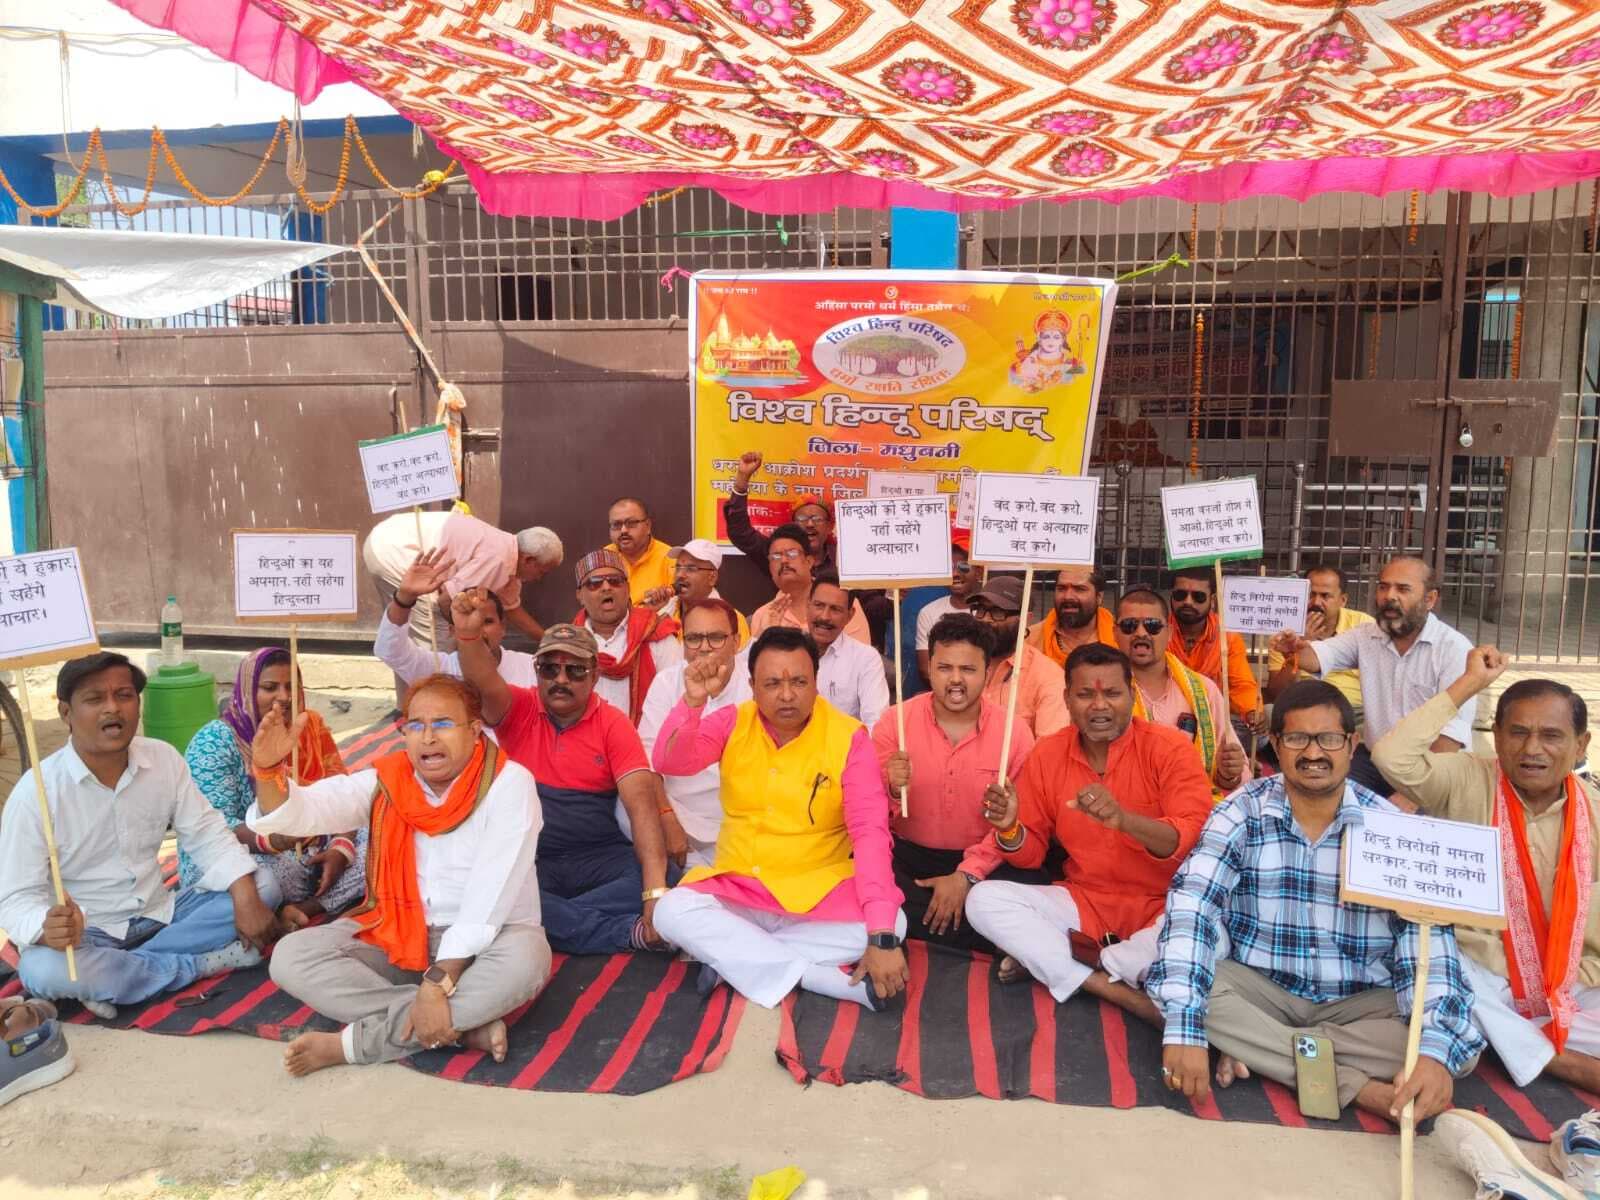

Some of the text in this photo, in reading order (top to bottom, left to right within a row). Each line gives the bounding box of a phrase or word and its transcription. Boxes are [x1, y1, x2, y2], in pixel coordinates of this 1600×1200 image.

[825, 322, 864, 344] विश्व
[727, 390, 1054, 442] विश्व हिन्दू परिषद्
[880, 441, 960, 462] मधुबनी
[765, 458, 816, 477] आक्रोश
[774, 480, 788, 495] के
[901, 500, 911, 515] ये
[993, 498, 1010, 512] बंद
[1040, 499, 1056, 513] बंद
[1170, 505, 1194, 518] ममता
[870, 520, 921, 536] नहीं सहेंगे
[1023, 521, 1038, 532] पर
[1042, 523, 1089, 535] अत्याचार
[1237, 517, 1248, 528] पर
[1011, 537, 1027, 552] बंद
[14, 559, 27, 577] ये
[299, 558, 313, 569] का
[318, 558, 334, 569] यह
[9, 580, 45, 601] सहेंगे
[1364, 829, 1484, 864] हिन्दू विरोधी ममता
[1446, 865, 1487, 884] चलेगी
